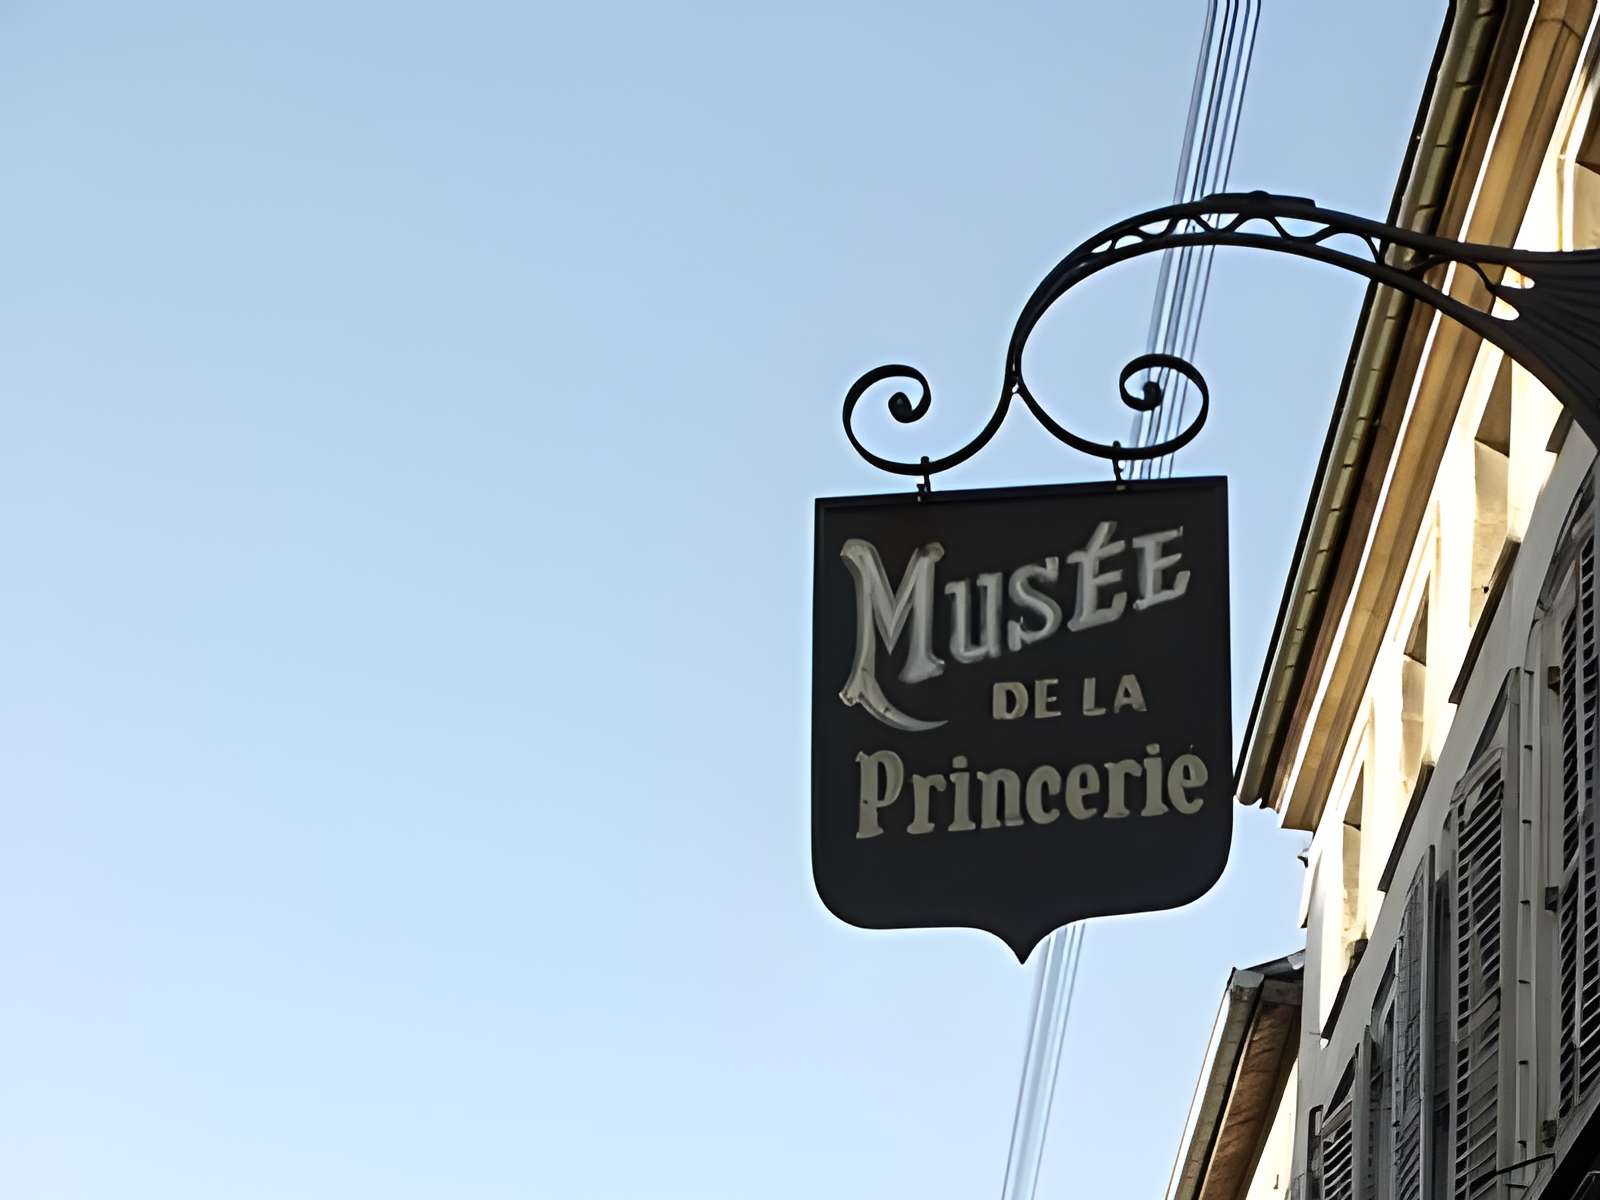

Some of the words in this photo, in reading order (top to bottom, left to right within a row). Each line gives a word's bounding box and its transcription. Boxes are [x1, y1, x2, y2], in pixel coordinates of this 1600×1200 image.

[992, 678, 1062, 720] DE
[1082, 674, 1147, 716] LA
[855, 743, 1208, 839] Princerie
